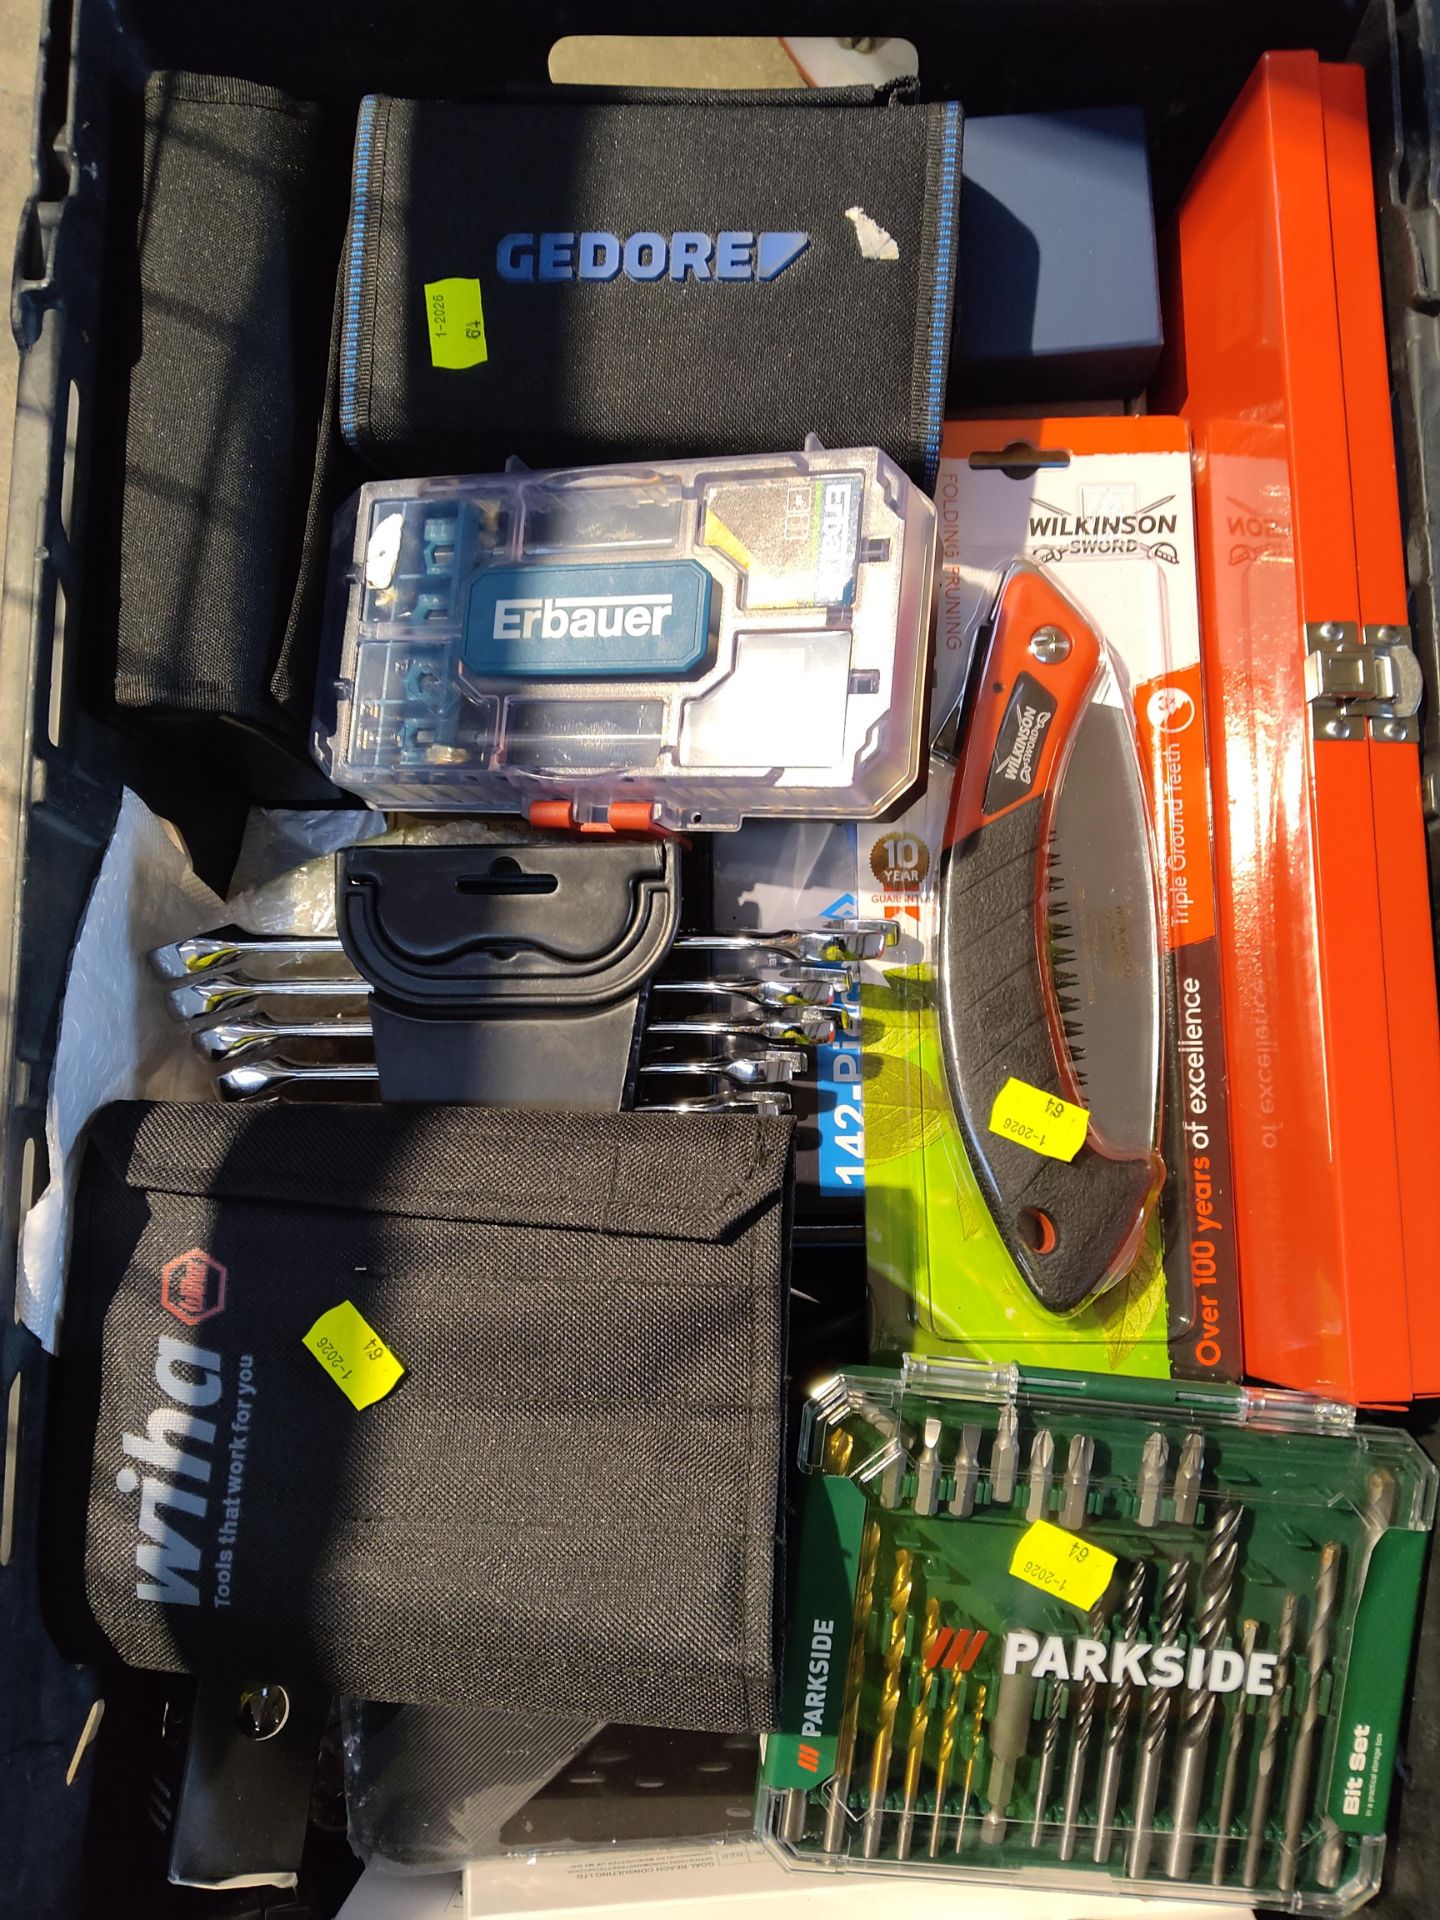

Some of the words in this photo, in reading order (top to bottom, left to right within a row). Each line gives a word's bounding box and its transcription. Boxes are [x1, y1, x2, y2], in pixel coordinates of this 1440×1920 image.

[497, 232, 756, 282] GEDORE
[433, 294, 446, 338] 1-2026
[465, 320, 481, 339] 64
[942, 474, 960, 558] FOLDING
[1029, 515, 1177, 536] WILKINSON
[1069, 539, 1138, 554] SWORD
[492, 594, 673, 640] Erbauer
[943, 565, 962, 650] PRUNING
[1005, 705, 1037, 781] WILKINSON
[1023, 730, 1039, 764] SWORD
[1163, 743, 1182, 794] Teeth
[883, 839, 919, 868] 10
[1163, 799, 1186, 871] Ground
[883, 870, 919, 882] YEAR
[1169, 876, 1194, 927] Triple
[1178, 976, 1203, 1110] excellence
[1045, 1098, 1064, 1119] 64
[1003, 1118, 1046, 1147] 1-2026
[1183, 1114, 1209, 1150] of
[1195, 1155, 1223, 1239] years
[1190, 1240, 1217, 1288] 100
[362, 1339, 384, 1361] 64
[1195, 1298, 1223, 1367] Over
[238, 1354, 257, 1396] you
[317, 1337, 352, 1380] 1-2026
[231, 1399, 251, 1433] for
[228, 1435, 248, 1494] work
[218, 1498, 241, 1545] that
[1068, 1542, 1089, 1564] 64
[214, 1549, 234, 1609] Tools
[1024, 1561, 1067, 1591] 1-2026
[802, 1618, 834, 1738] PARKSIDE
[1003, 1631, 1279, 1697] PARKSIDE
[1348, 1724, 1370, 1772] Set
[1371, 1746, 1382, 1773] storage
[1375, 1733, 1383, 1747] box
[1342, 1776, 1363, 1816] Bit
[1368, 1773, 1377, 1803] practical
[595, 1867, 656, 1878] CONSULTING
[656, 1863, 684, 1872] REACH
[687, 1861, 715, 1869] GOAL
